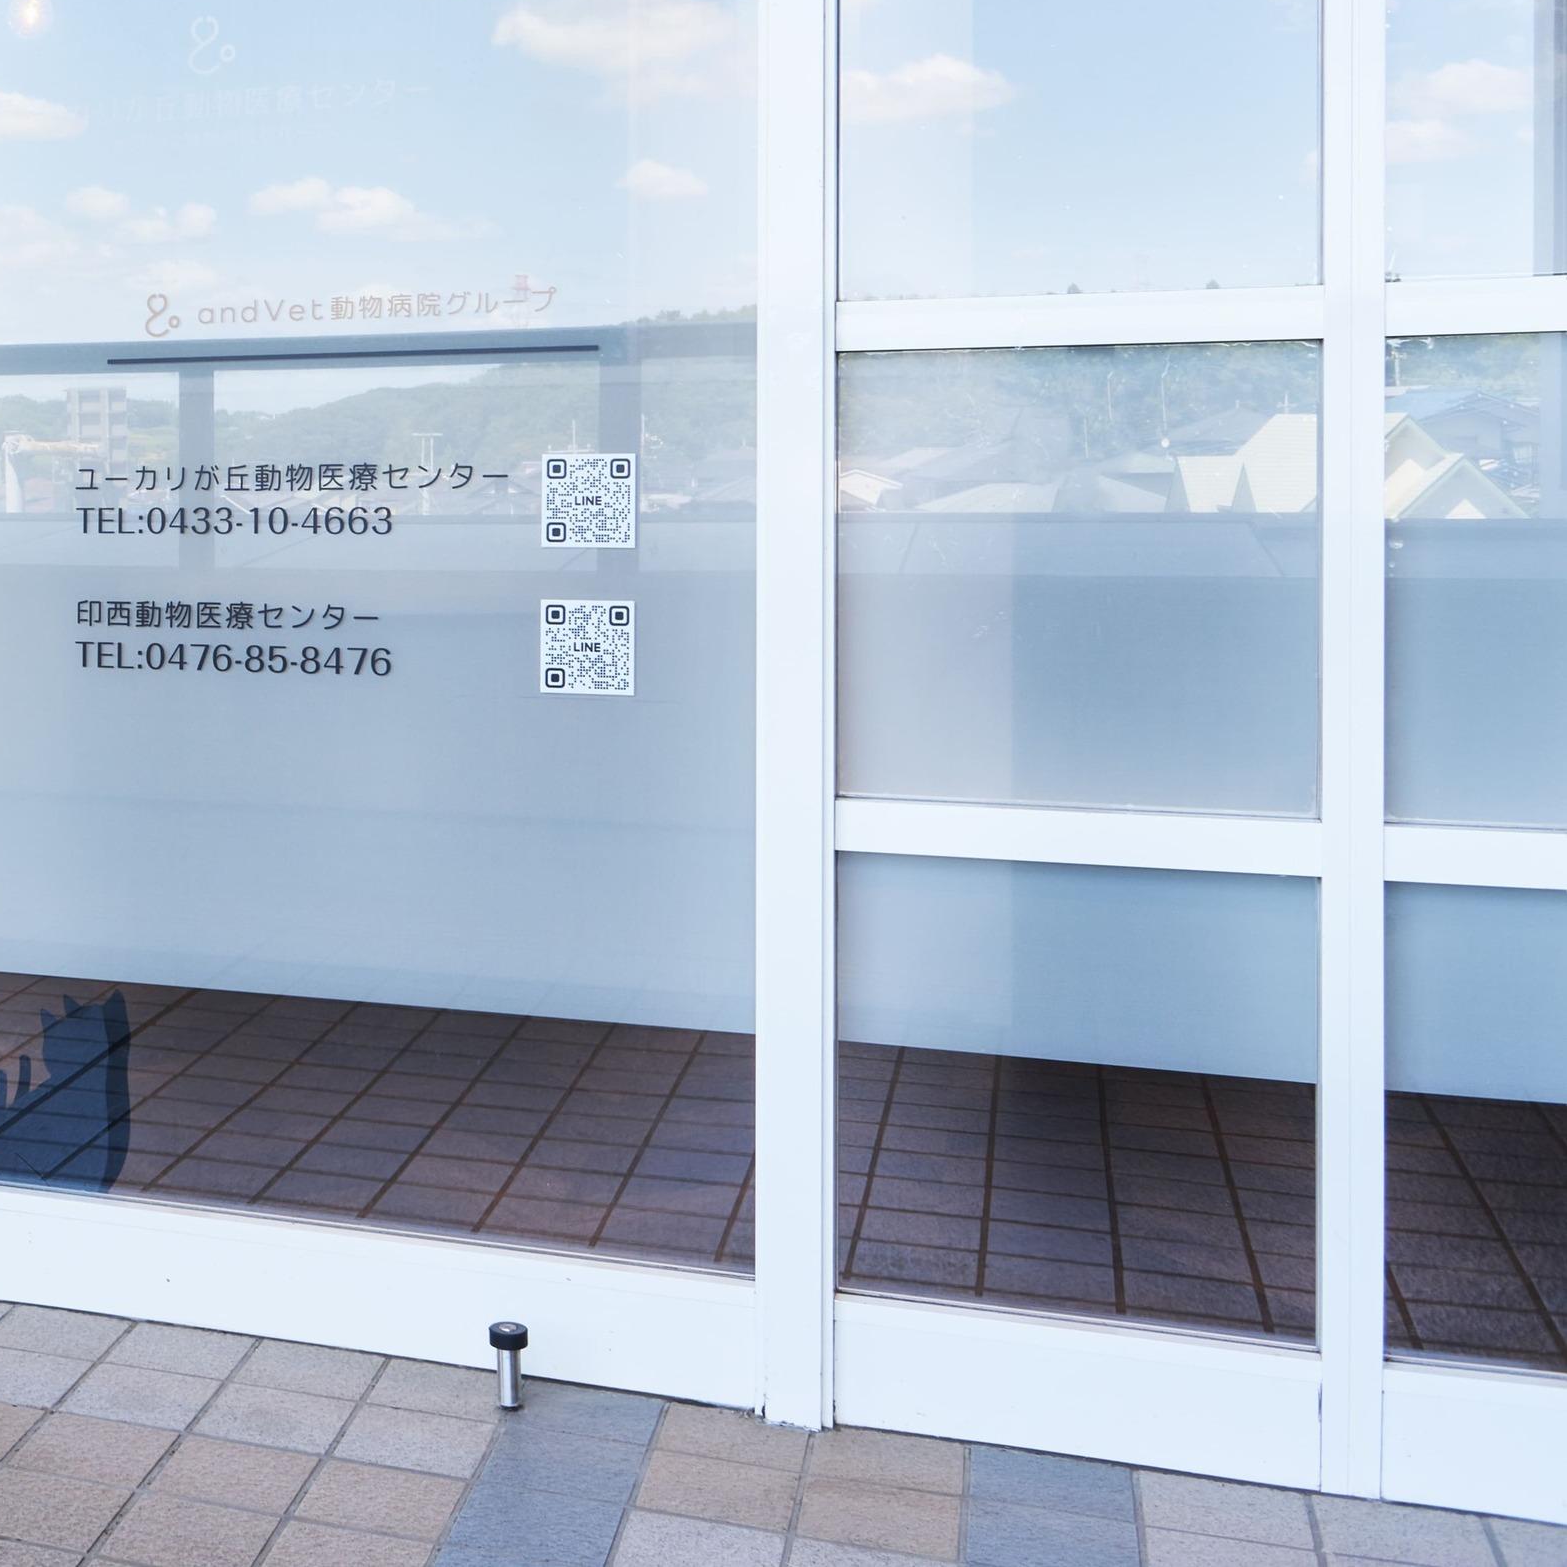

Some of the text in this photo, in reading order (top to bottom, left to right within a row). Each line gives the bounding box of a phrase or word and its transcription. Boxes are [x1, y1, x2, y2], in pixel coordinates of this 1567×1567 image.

[198, 286, 557, 326] andVet動物病院グループ
[75, 462, 511, 494] ユーカリが丘動物医療センター
[574, 495, 603, 507] LINE
[76, 505, 395, 537] TEL:0433-10-4663
[75, 598, 381, 632] 印西動物医療センター
[75, 641, 394, 677] TEL:0476-85-8476
[573, 641, 602, 653] LINE
